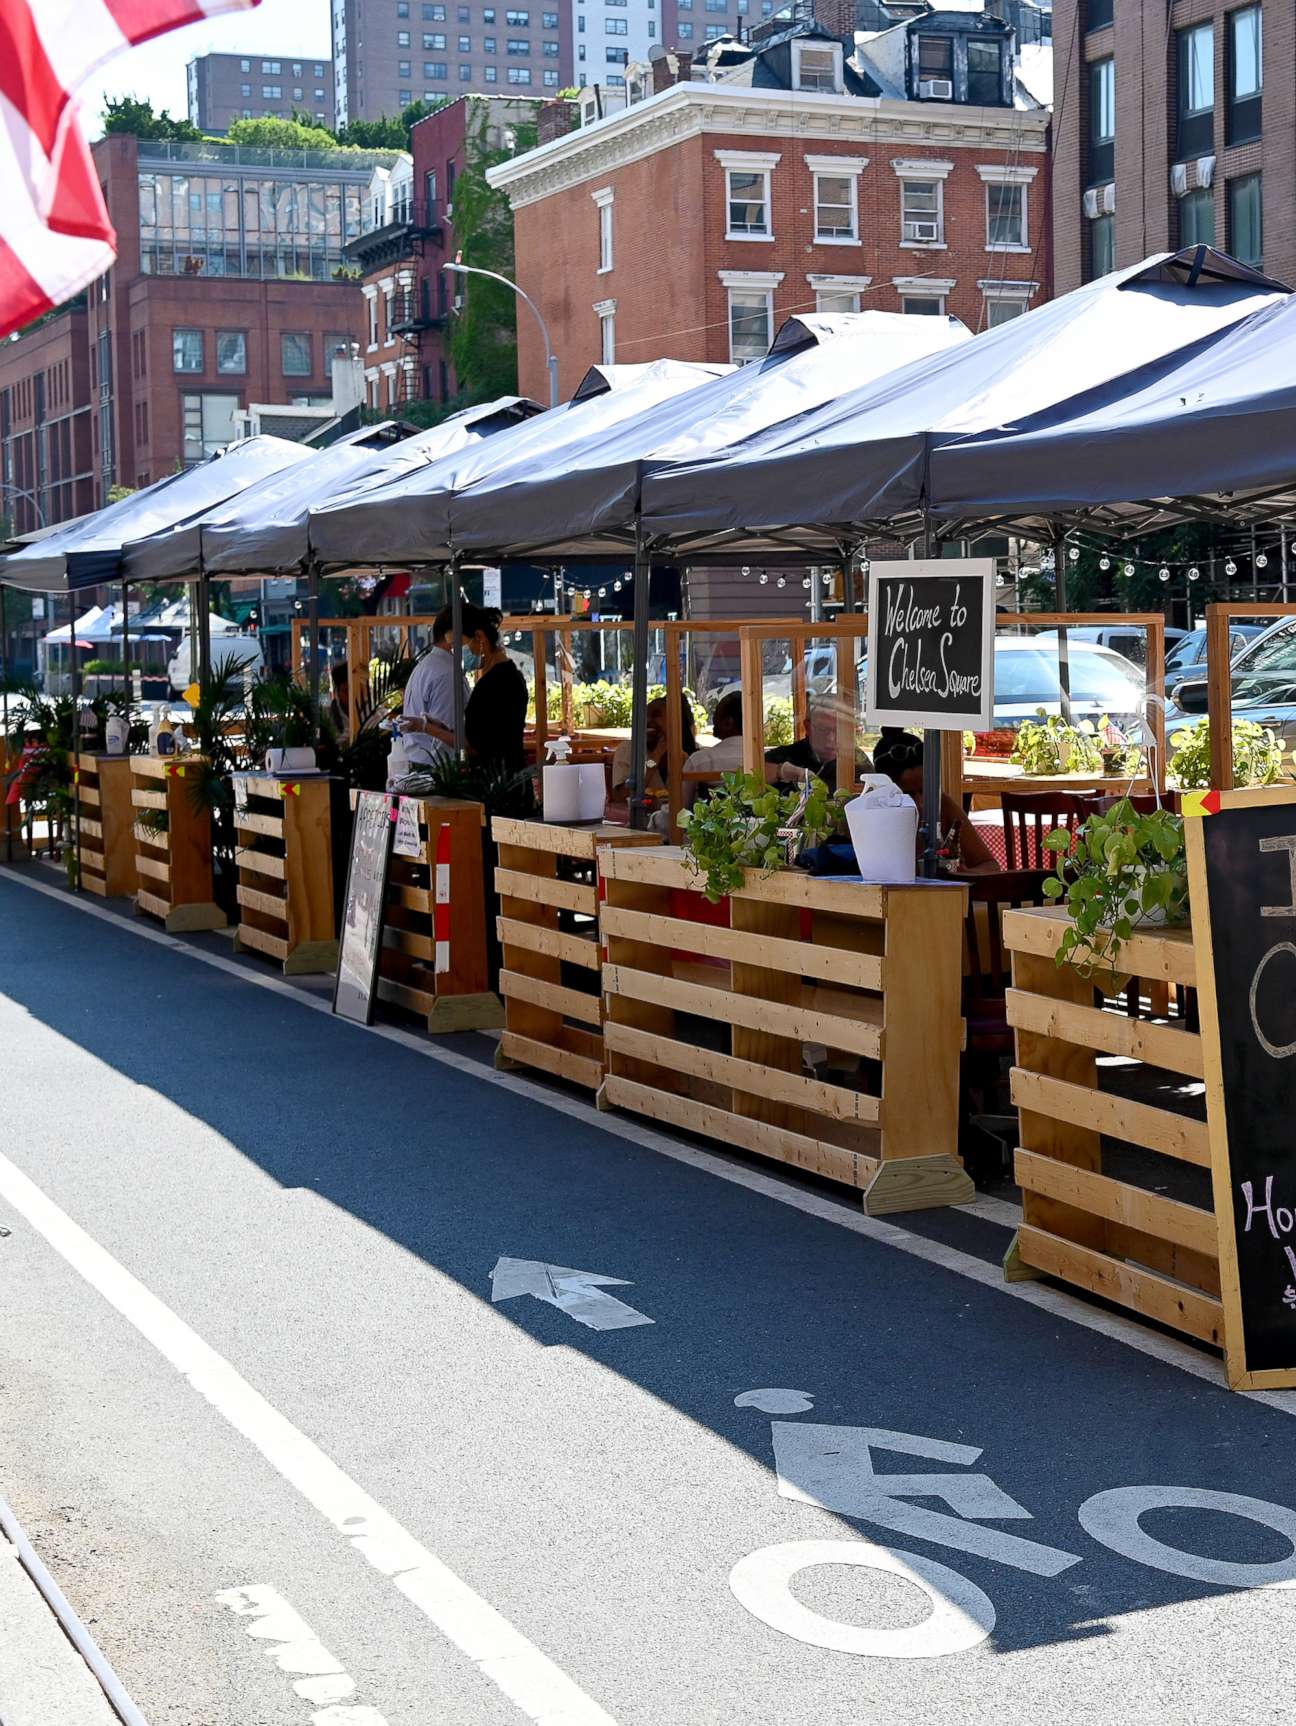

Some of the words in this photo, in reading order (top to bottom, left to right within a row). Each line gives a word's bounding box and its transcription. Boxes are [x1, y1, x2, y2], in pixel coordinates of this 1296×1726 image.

[885, 584, 942, 637] Welcome
[950, 584, 967, 628] to
[888, 637, 938, 699] Chelsea
[937, 632, 981, 698] Square
